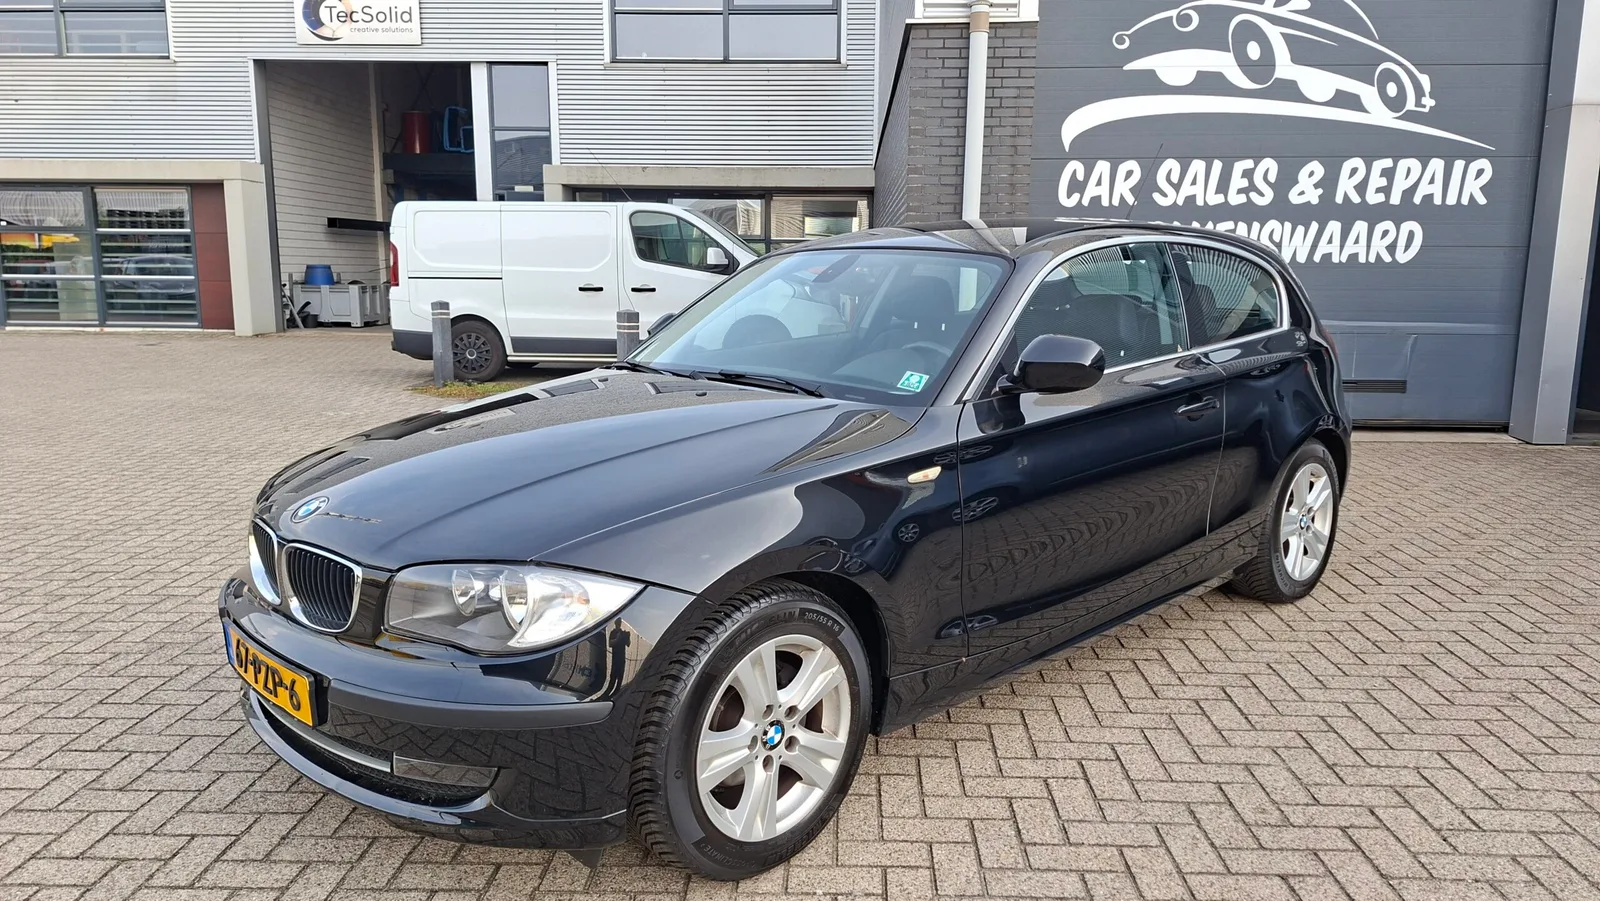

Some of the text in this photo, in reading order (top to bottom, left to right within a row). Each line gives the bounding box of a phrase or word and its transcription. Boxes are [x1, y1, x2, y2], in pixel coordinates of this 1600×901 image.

[324, 5, 413, 23] TecSolid
[1058, 157, 1493, 207] CAR SALES & REPAIR
[803, 612, 827, 624] 205/55
[832, 623, 840, 632] 16
[235, 638, 301, 711] 67-PZP-6
